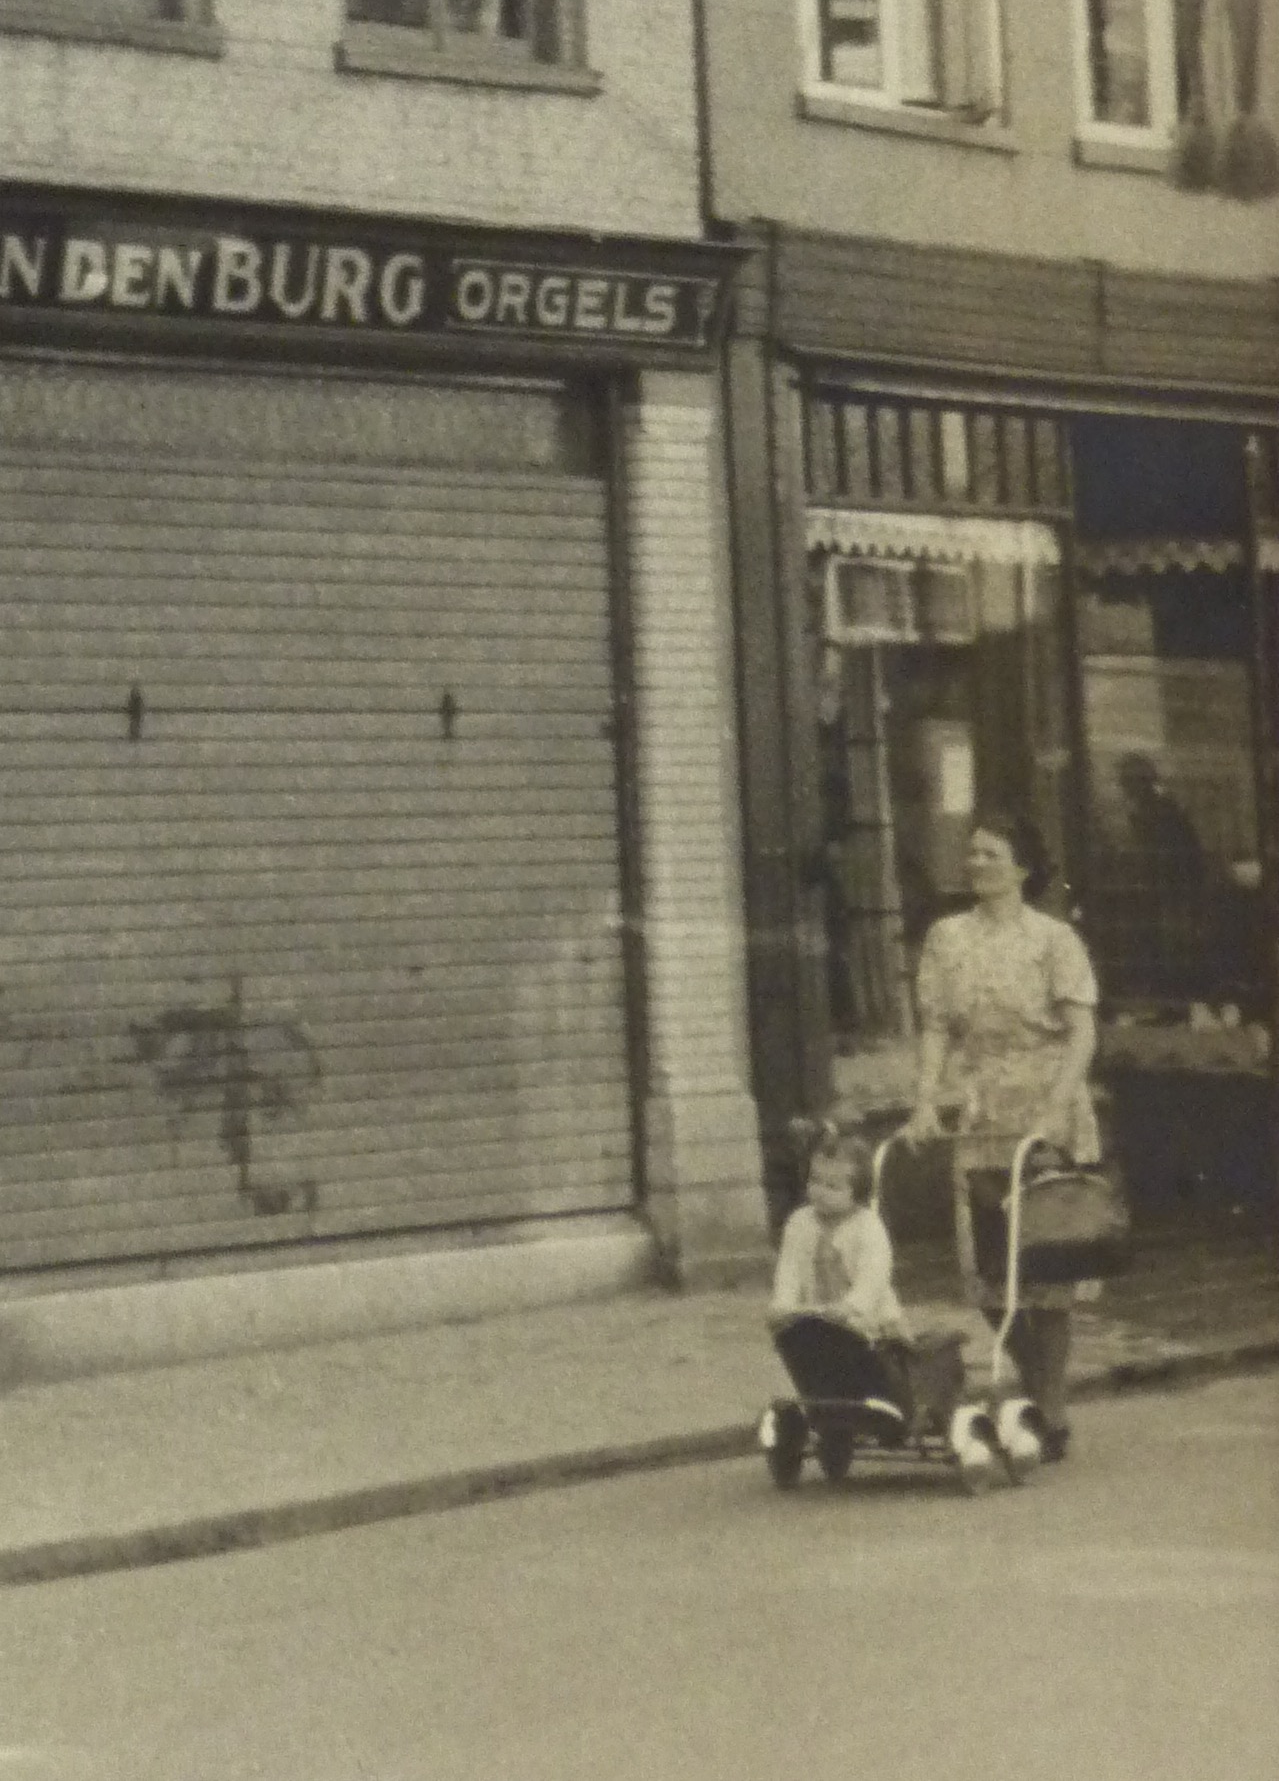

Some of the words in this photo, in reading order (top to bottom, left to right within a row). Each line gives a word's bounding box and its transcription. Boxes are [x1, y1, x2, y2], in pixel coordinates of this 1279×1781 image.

[60, 238, 202, 308] DEN
[212, 235, 425, 325] BURG
[453, 270, 678, 334] ORGELS
